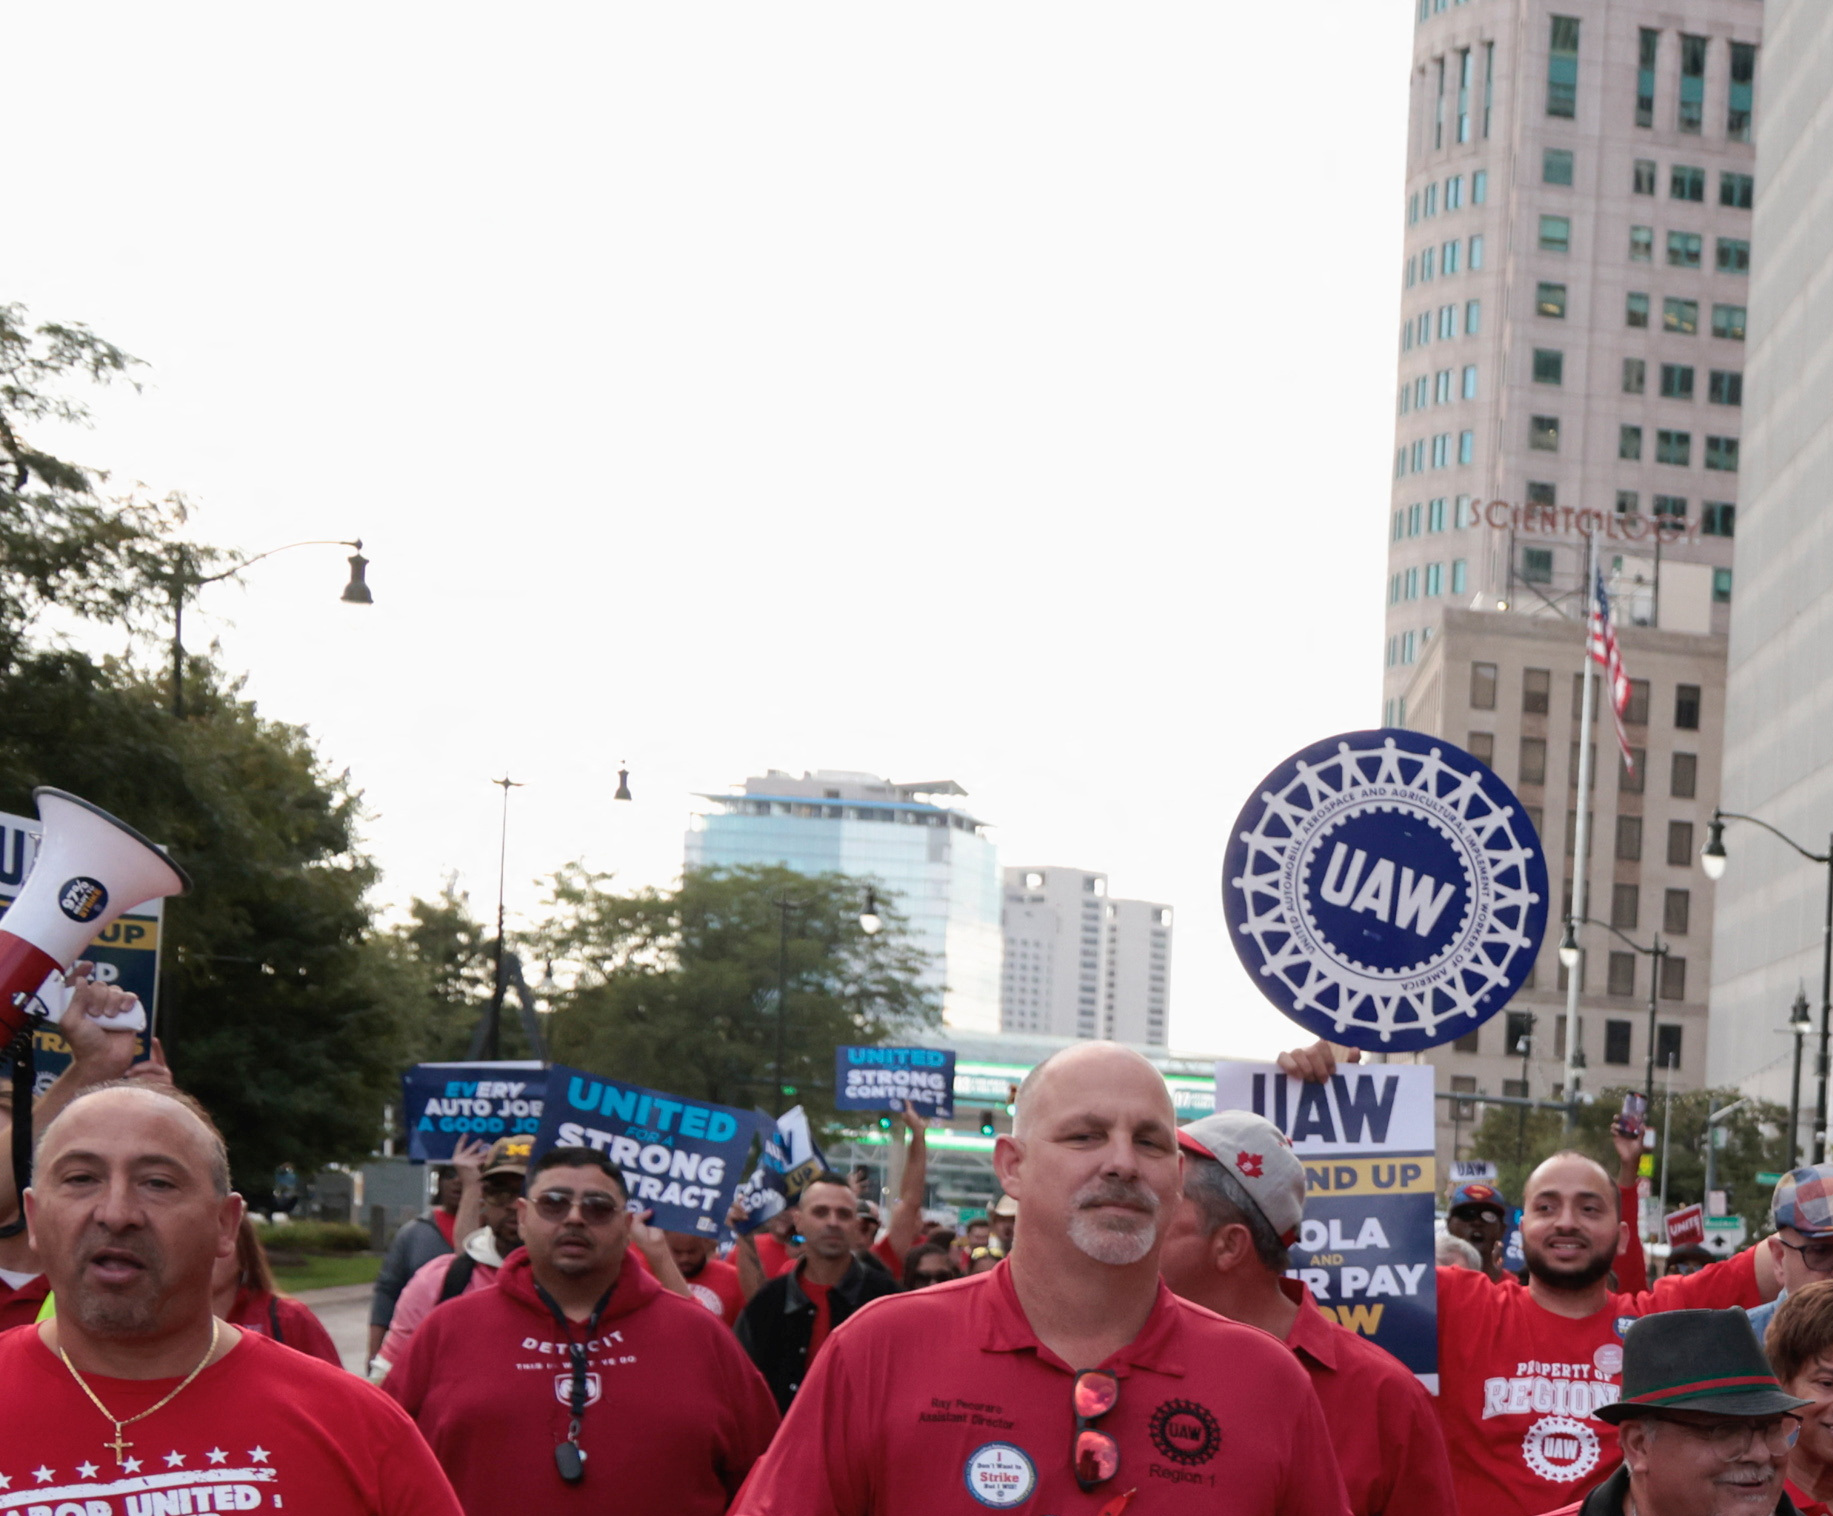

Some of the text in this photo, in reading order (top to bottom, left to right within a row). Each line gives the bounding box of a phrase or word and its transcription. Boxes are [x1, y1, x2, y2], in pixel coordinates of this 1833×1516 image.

[1285, 787, 1490, 992] UNITED AUTOMOBILE, AEROSPACE AND AGRICULTURAL IMPLEMENT WORKERS OF AMERICA
[1321, 841, 1456, 937] UAW
[847, 1048, 946, 1067] UNITED
[445, 1081, 526, 1098] EVERY
[847, 1069, 945, 1090] STRONG
[845, 1086, 946, 1104] CONTRACT
[424, 1098, 493, 1117] AUTO
[567, 1076, 737, 1143] UNITED
[1253, 1074, 1400, 1143] UAW
[418, 1117, 539, 1133] A GOOD JO
[625, 1126, 674, 1147] FOR A
[555, 1122, 725, 1185] STRONG
[1372, 1164, 1422, 1189] UP
[1457, 1162, 1487, 1177] UAW
[625, 1174, 721, 1211] TRACT
[1298, 1217, 1390, 1251] OLA
[1310, 1254, 1343, 1266] AND
[1341, 1264, 1426, 1299] PAY
[1516, 1361, 1590, 1378] PROPERTY
[1482, 1376, 1621, 1421] REGION
[919, 1412, 1015, 1430] Assistant Director
[1169, 1422, 1202, 1441] UAW
[997, 1452, 1002, 1462] I
[1543, 1437, 1578, 1460] UAW
[980, 1472, 1019, 1483] Strike
[1150, 1464, 1216, 1486] Region 1
